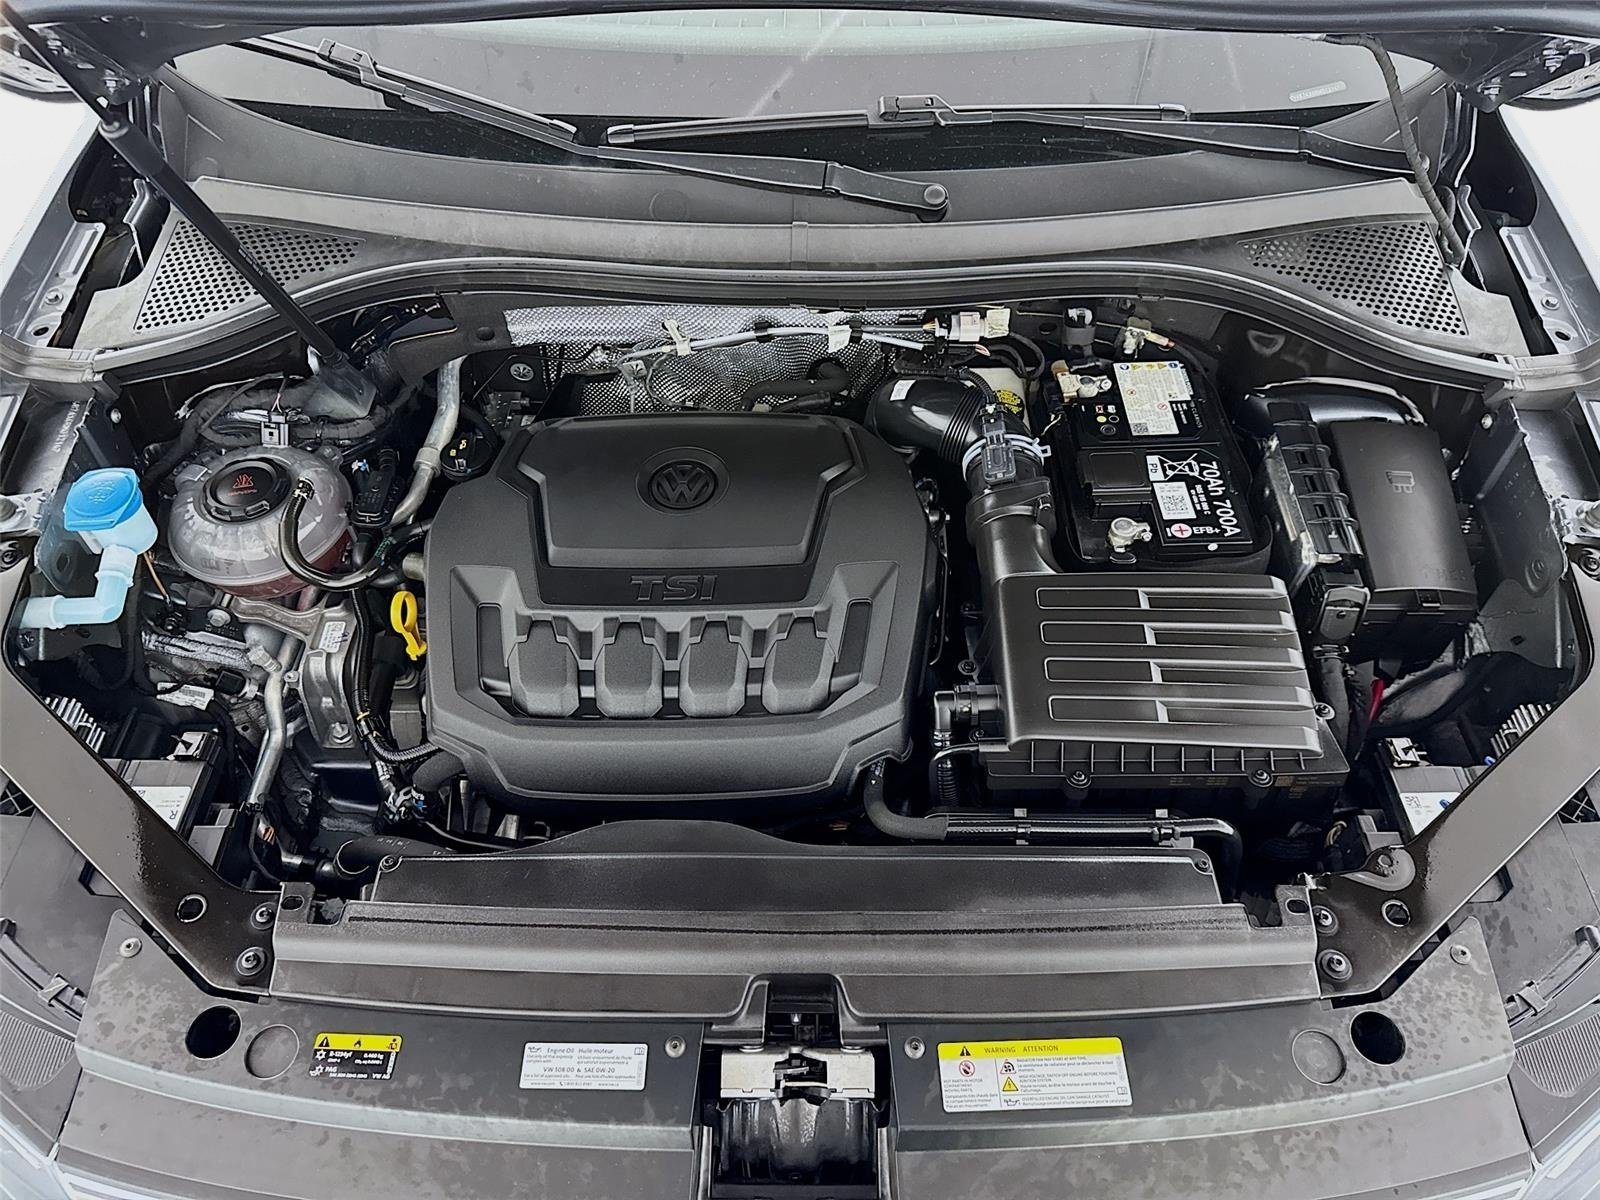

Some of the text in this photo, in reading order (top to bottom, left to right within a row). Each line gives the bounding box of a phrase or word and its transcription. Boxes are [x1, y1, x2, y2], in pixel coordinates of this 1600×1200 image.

[1149, 463, 1158, 474] Pb
[1200, 461, 1226, 496] 70Ah
[1213, 499, 1241, 537] 700A
[630, 574, 718, 601] TSI
[984, 1046, 1016, 1054] WARNING
